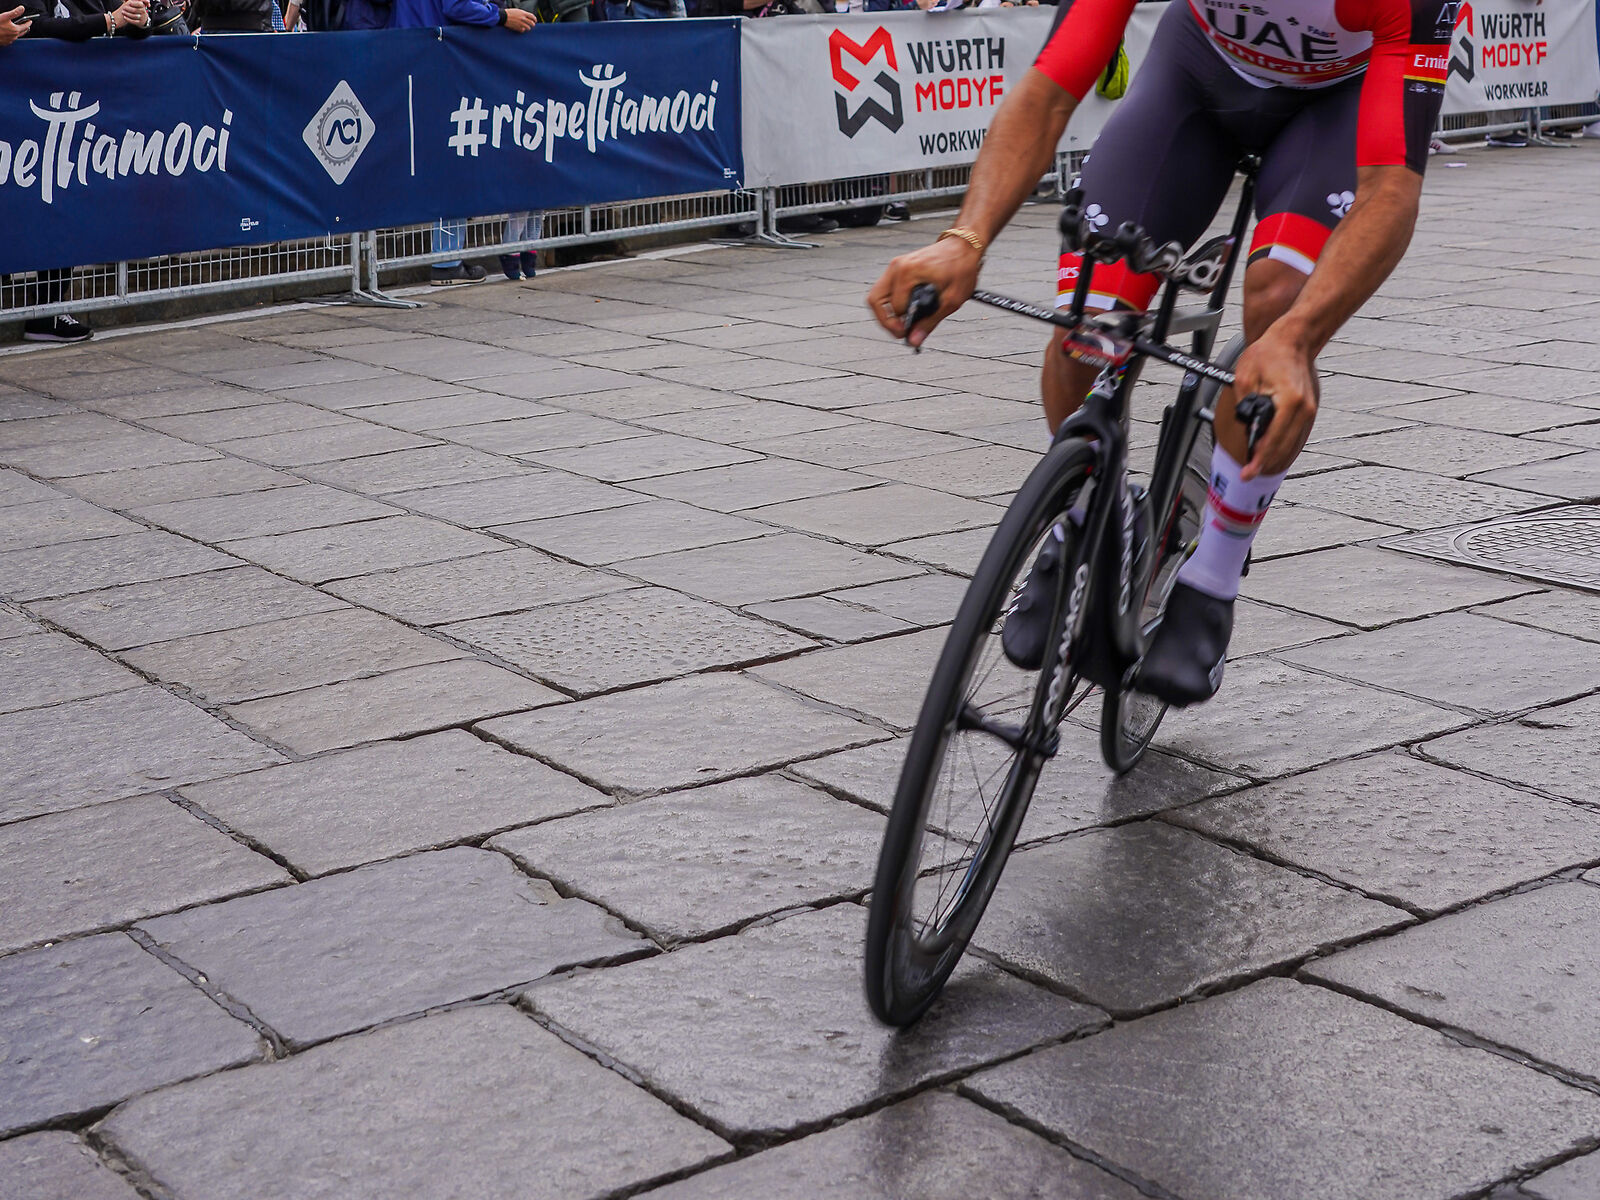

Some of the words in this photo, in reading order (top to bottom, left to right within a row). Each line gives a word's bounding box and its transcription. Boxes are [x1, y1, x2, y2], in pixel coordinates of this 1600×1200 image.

[1205, 7, 1343, 64] UAE
[1480, 11, 1546, 40] WÜRTH
[907, 36, 1005, 75] WÜRTH
[1482, 41, 1548, 69] MODYF
[914, 74, 1005, 113] MODYF
[1483, 80, 1549, 102] WORKWEAR
[447, 62, 720, 164] #rispettiamoci
[325, 116, 362, 147] ACI
[919, 128, 988, 156] WORKW
[1174, 353, 1236, 384] COLNAG
